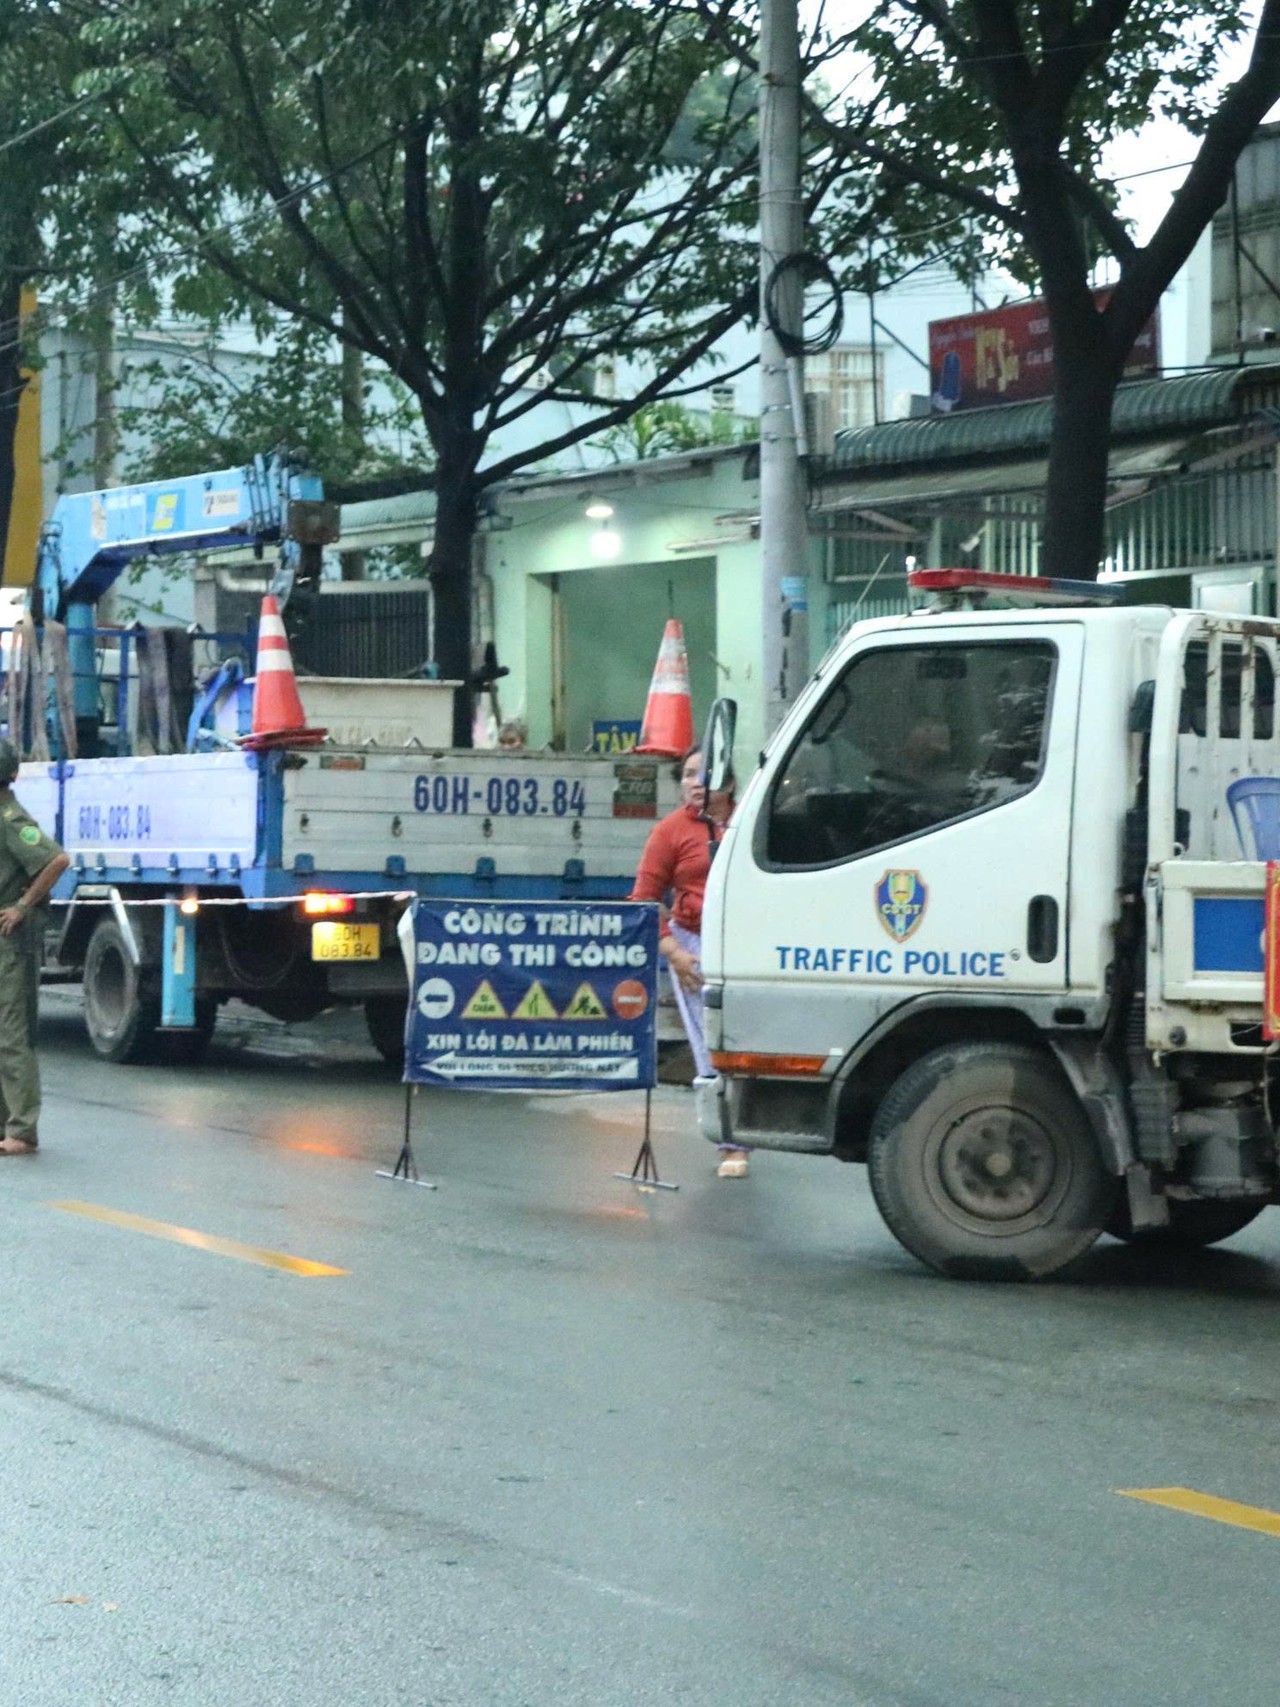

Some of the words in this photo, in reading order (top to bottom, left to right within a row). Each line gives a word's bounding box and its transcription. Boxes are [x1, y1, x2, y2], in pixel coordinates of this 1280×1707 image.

[414, 775, 585, 816] 60H-083.84
[444, 908, 527, 936] CÔNG
[534, 910, 622, 937] TRÌNH
[417, 941, 502, 966] ĐANG
[508, 943, 556, 967] THI
[565, 940, 648, 968] CÔNG
[776, 946, 892, 974] TRAFFIC
[904, 951, 1005, 977] POLICE
[426, 1034, 461, 1050] XIN
